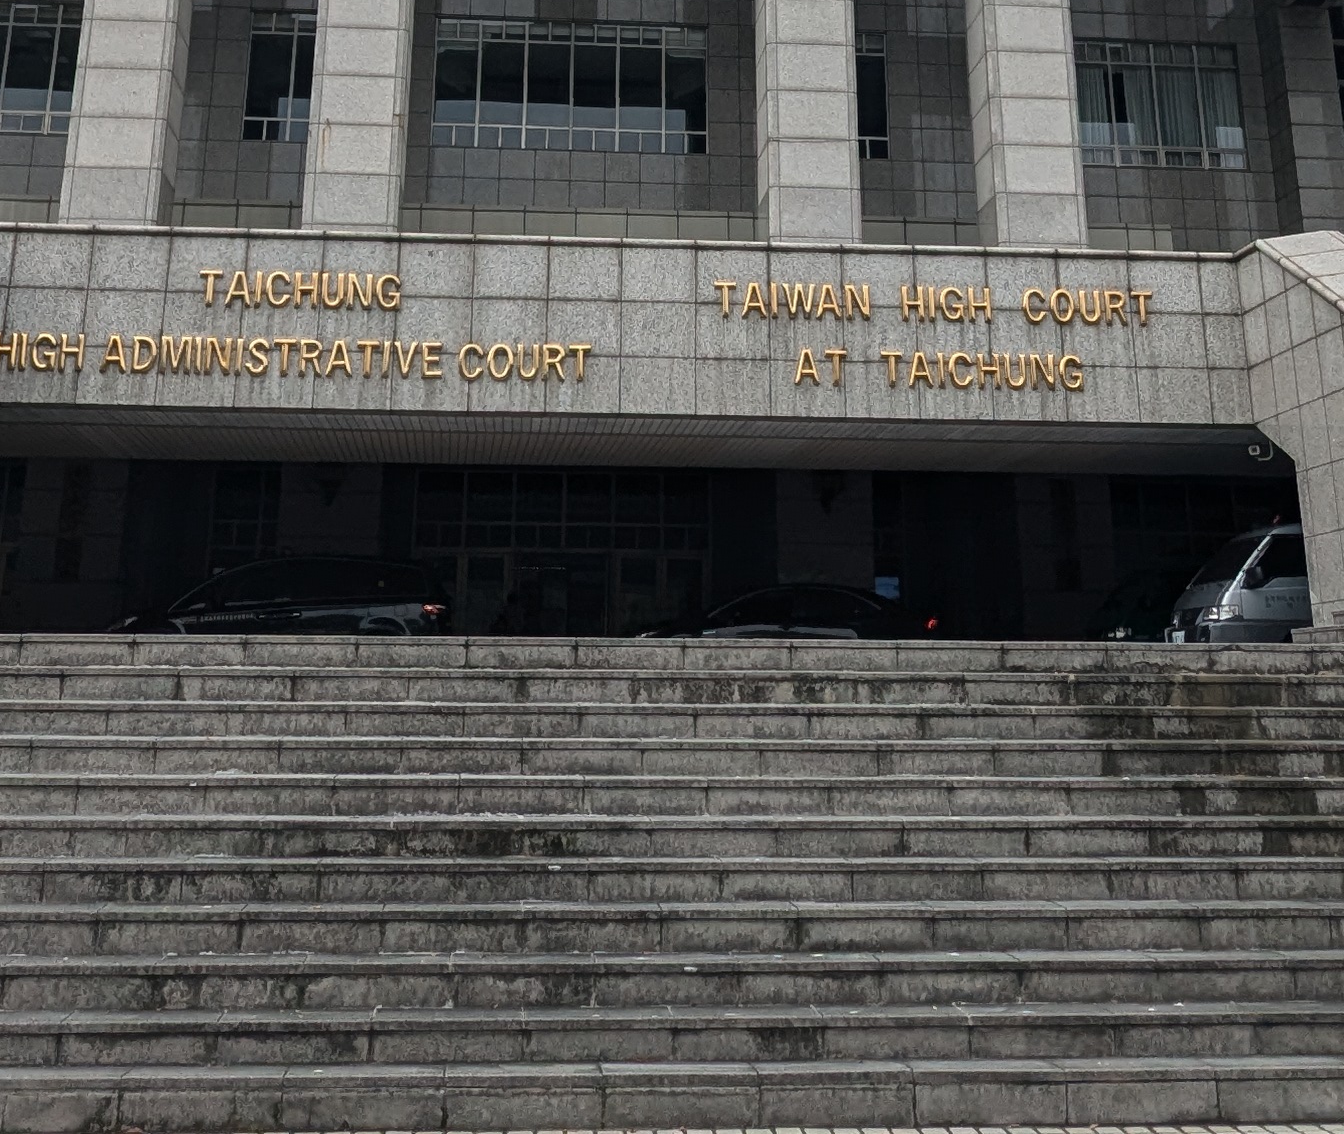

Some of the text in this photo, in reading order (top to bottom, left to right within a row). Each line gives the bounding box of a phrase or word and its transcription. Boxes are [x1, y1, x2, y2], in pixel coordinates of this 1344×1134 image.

[200, 269, 402, 312] TAICHUNG
[713, 281, 1154, 327] TAIWAN HIGH COURT
[101, 334, 446, 380] ADMINISTRATIVE
[460, 343, 593, 383] COURT
[795, 347, 1086, 392] AT TAICHUNG
